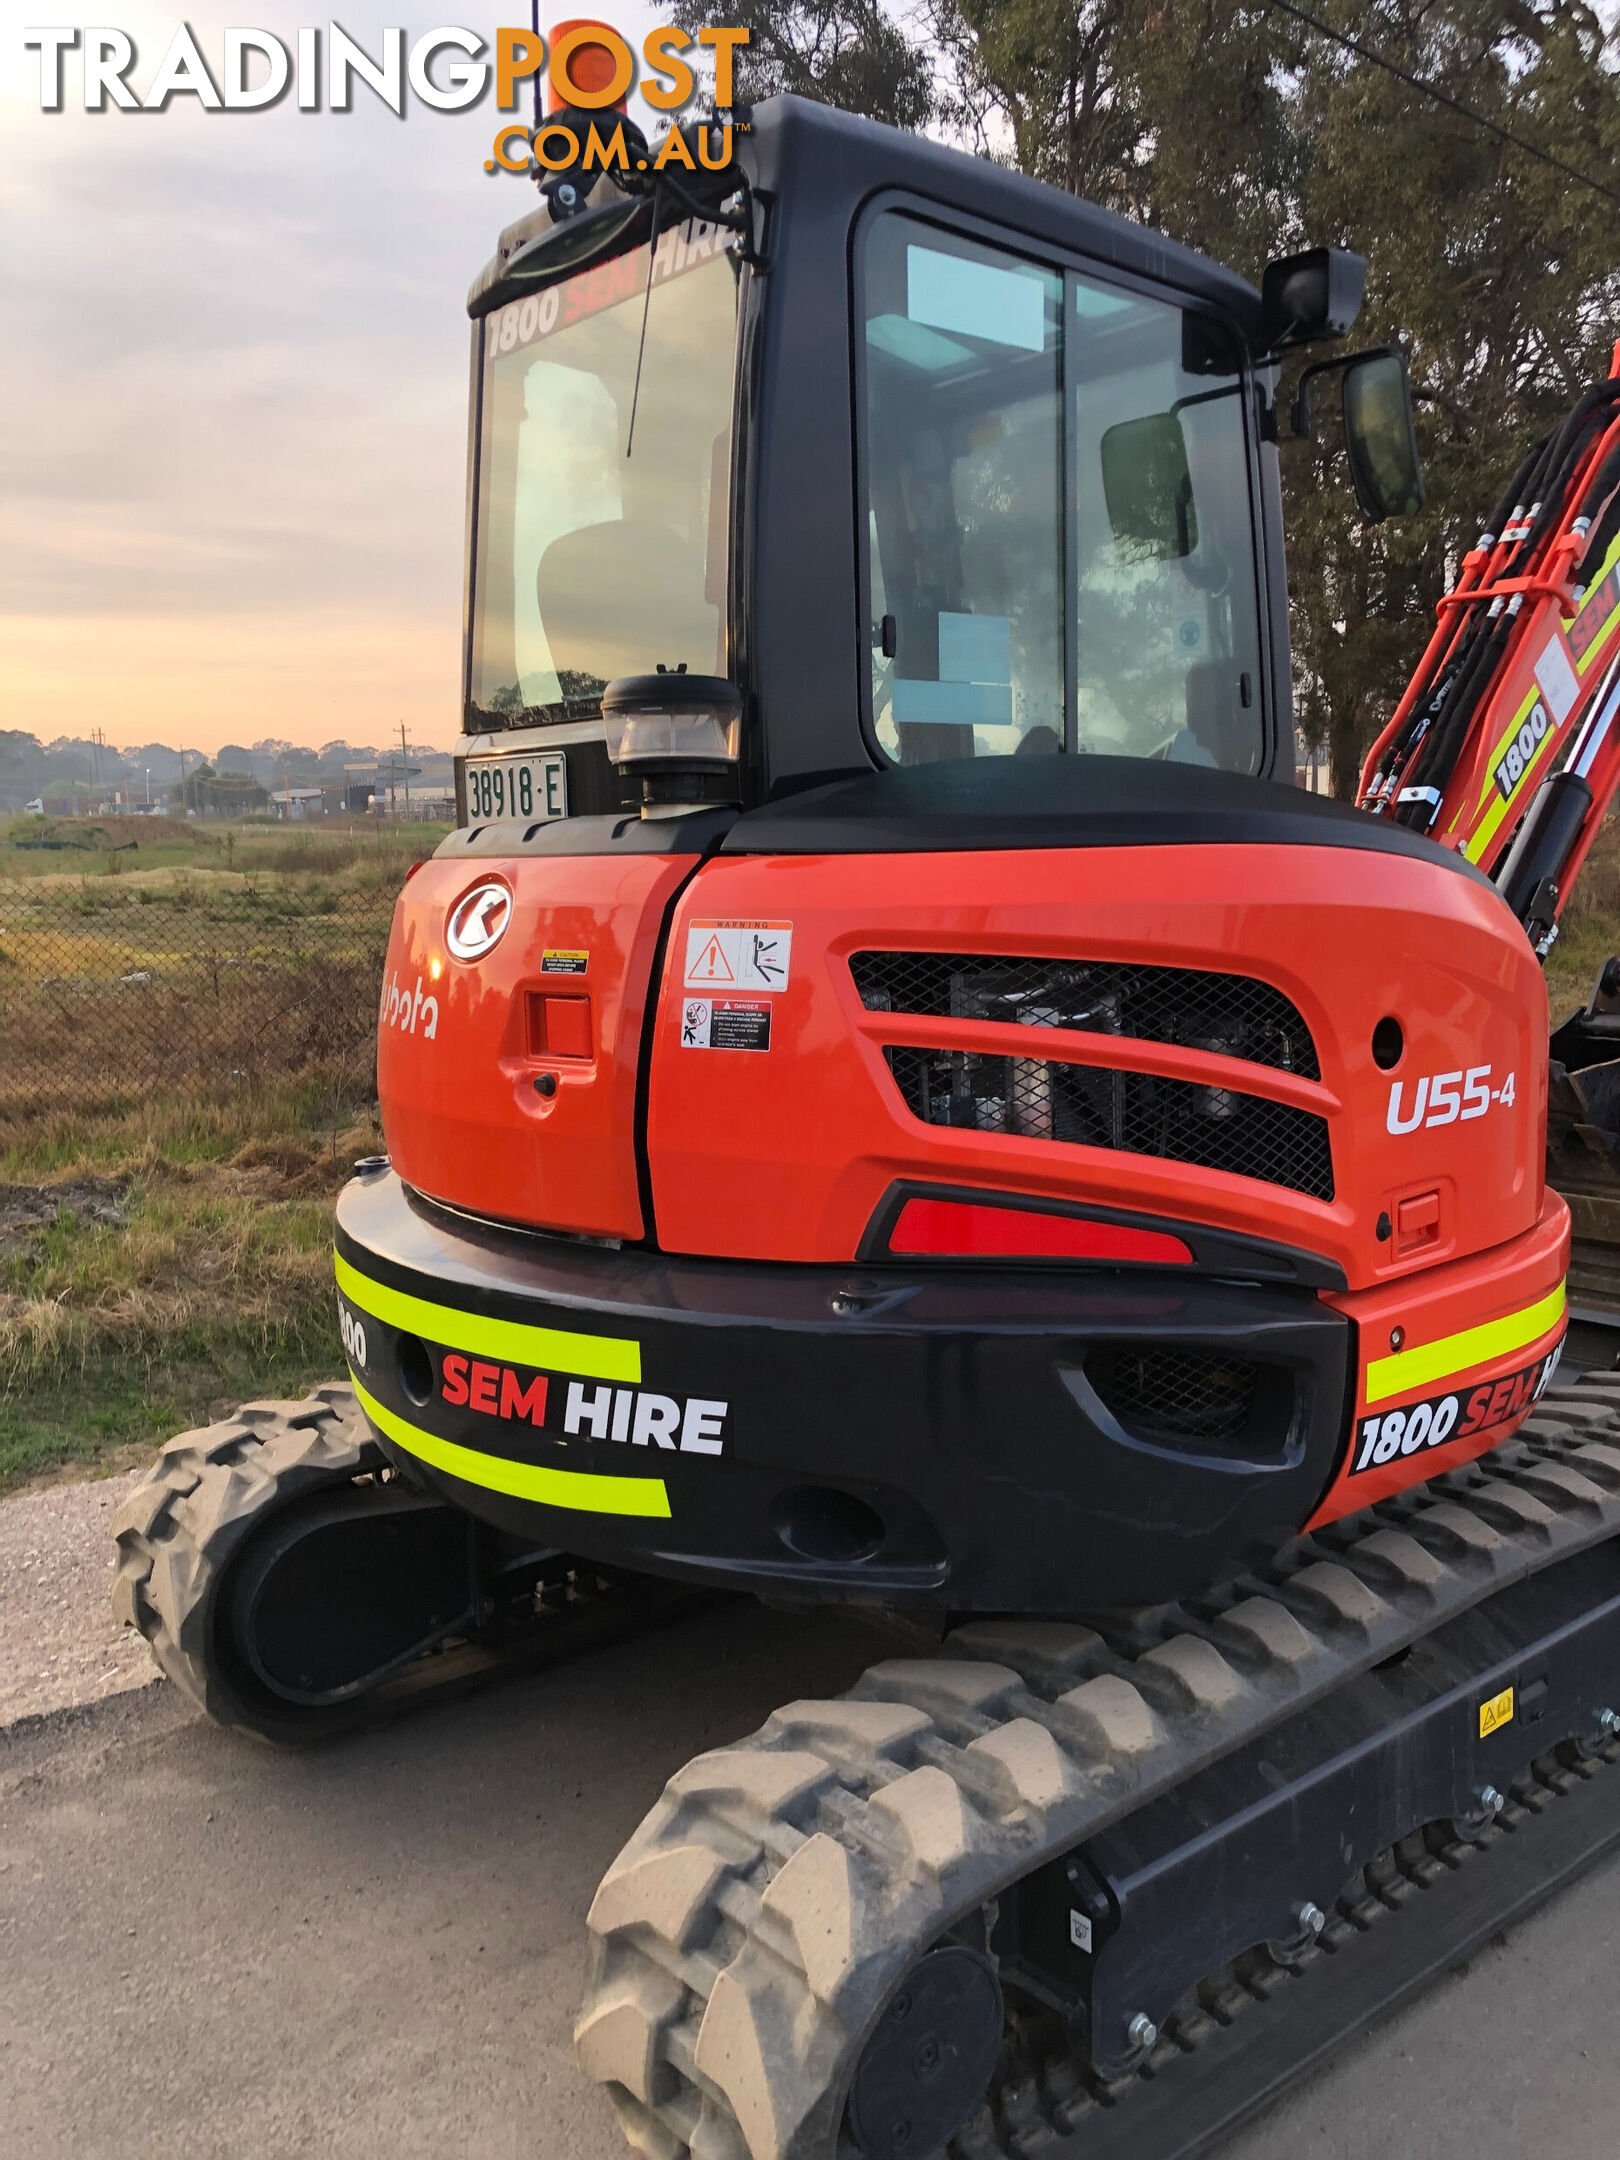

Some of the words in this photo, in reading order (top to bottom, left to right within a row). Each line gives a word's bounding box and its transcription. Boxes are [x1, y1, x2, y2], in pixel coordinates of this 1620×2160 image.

[489, 287, 560, 358] 1800
[565, 244, 638, 322] SEM
[1571, 575, 1616, 663] SEM
[1497, 703, 1547, 794] 1800
[716, 920, 768, 929] WARNING
[381, 967, 439, 1040] ubota
[1386, 1065, 1515, 1135] U55-4
[441, 1353, 549, 1428] SEM
[564, 1381, 728, 1456] HIRE
[1356, 1395, 1459, 1471] 1800
[1457, 1365, 1540, 1436] SEM
